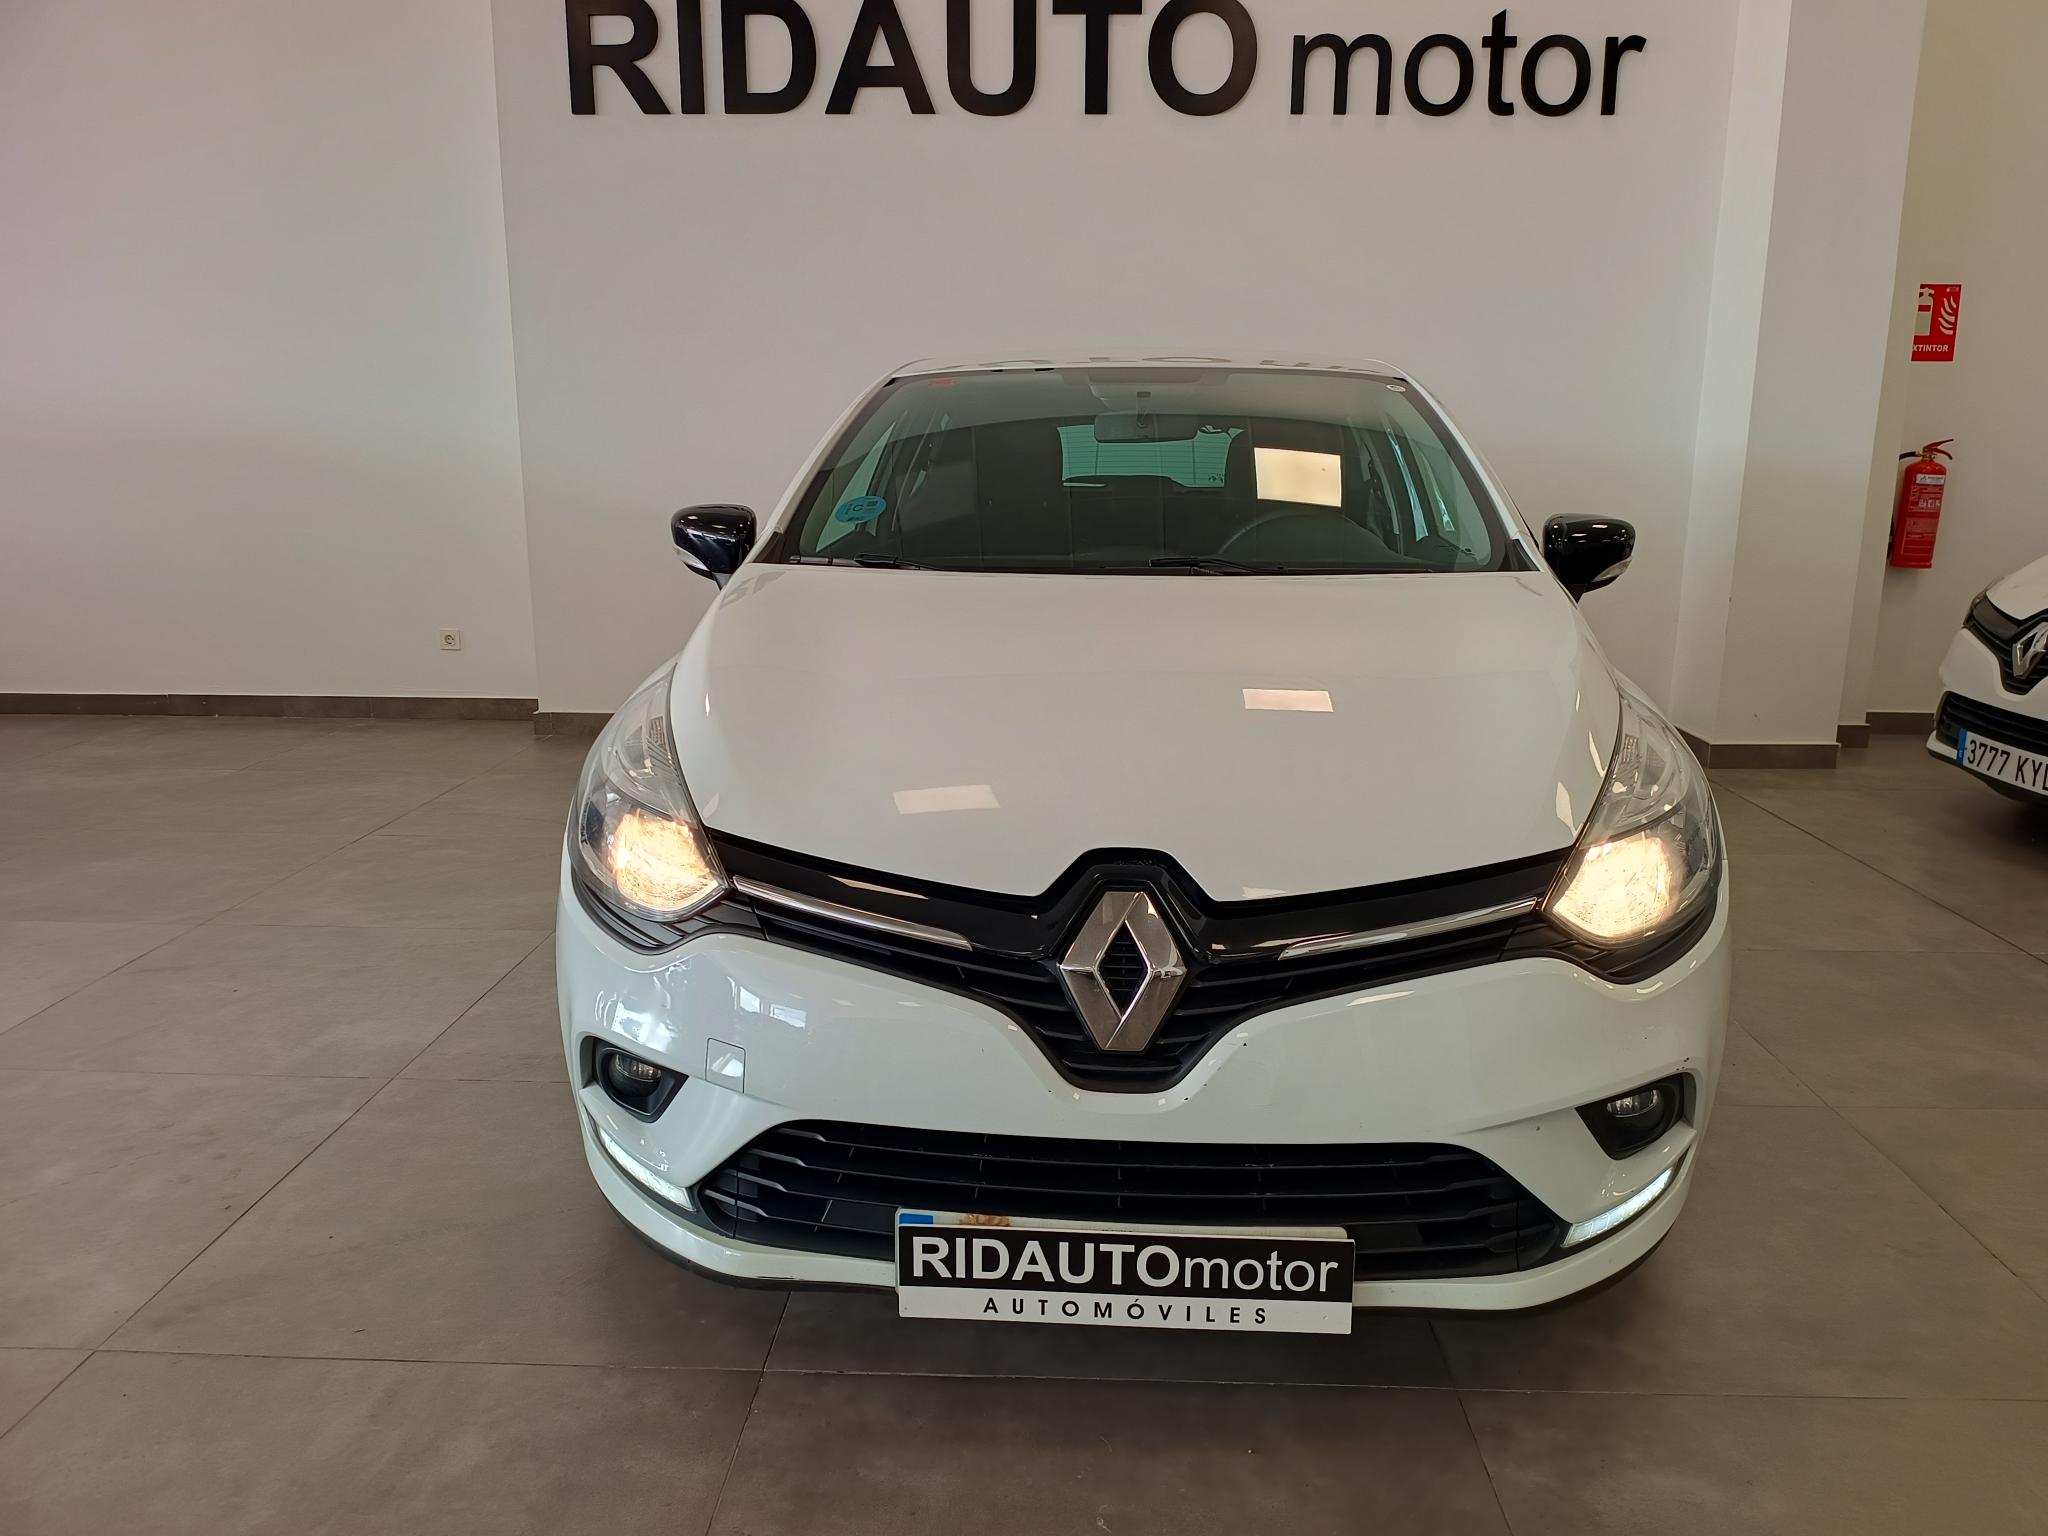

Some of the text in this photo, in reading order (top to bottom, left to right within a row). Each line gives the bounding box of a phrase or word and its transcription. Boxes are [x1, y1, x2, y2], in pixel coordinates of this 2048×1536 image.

[565, 0, 1647, 117] RIDAUTO motor
[1911, 344, 1949, 353] XTINTOR
[1967, 739, 2011, 776] 3777
[911, 1236, 1339, 1293] RIDAUTOmotor
[983, 1297, 1267, 1325] AUTOMÓVILES
